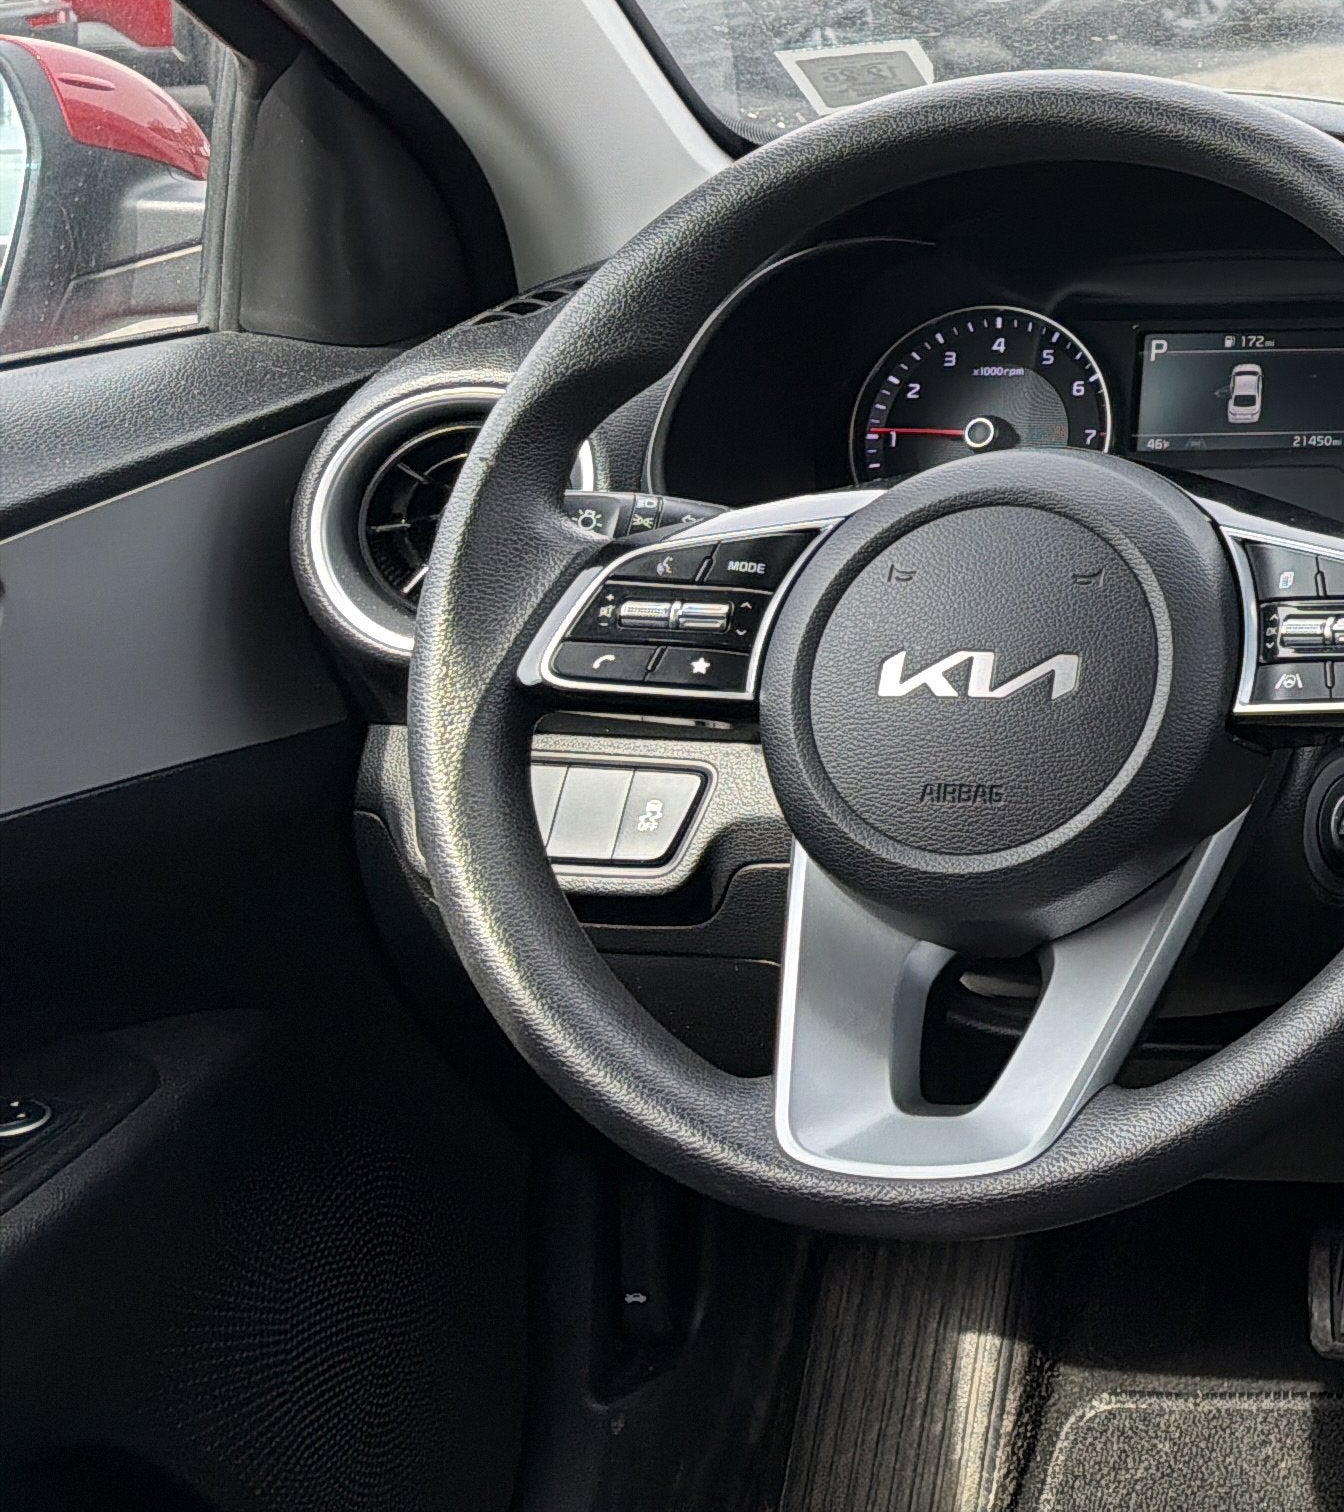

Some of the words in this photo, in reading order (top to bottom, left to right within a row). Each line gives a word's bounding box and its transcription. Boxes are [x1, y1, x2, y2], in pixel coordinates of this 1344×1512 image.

[991, 337, 1007, 354] 4
[1149, 339, 1168, 362] P
[943, 351, 957, 367] 3
[1041, 349, 1055, 365] 5
[970, 366, 1026, 378] x1000rpm
[906, 383, 921, 399] 2
[1071, 380, 1086, 397] 6
[889, 431, 897, 448] 1
[1083, 428, 1097, 445] 7
[727, 560, 767, 575] MODE
[877, 650, 1080, 701] KIA
[919, 782, 1003, 805] AIRBAG
